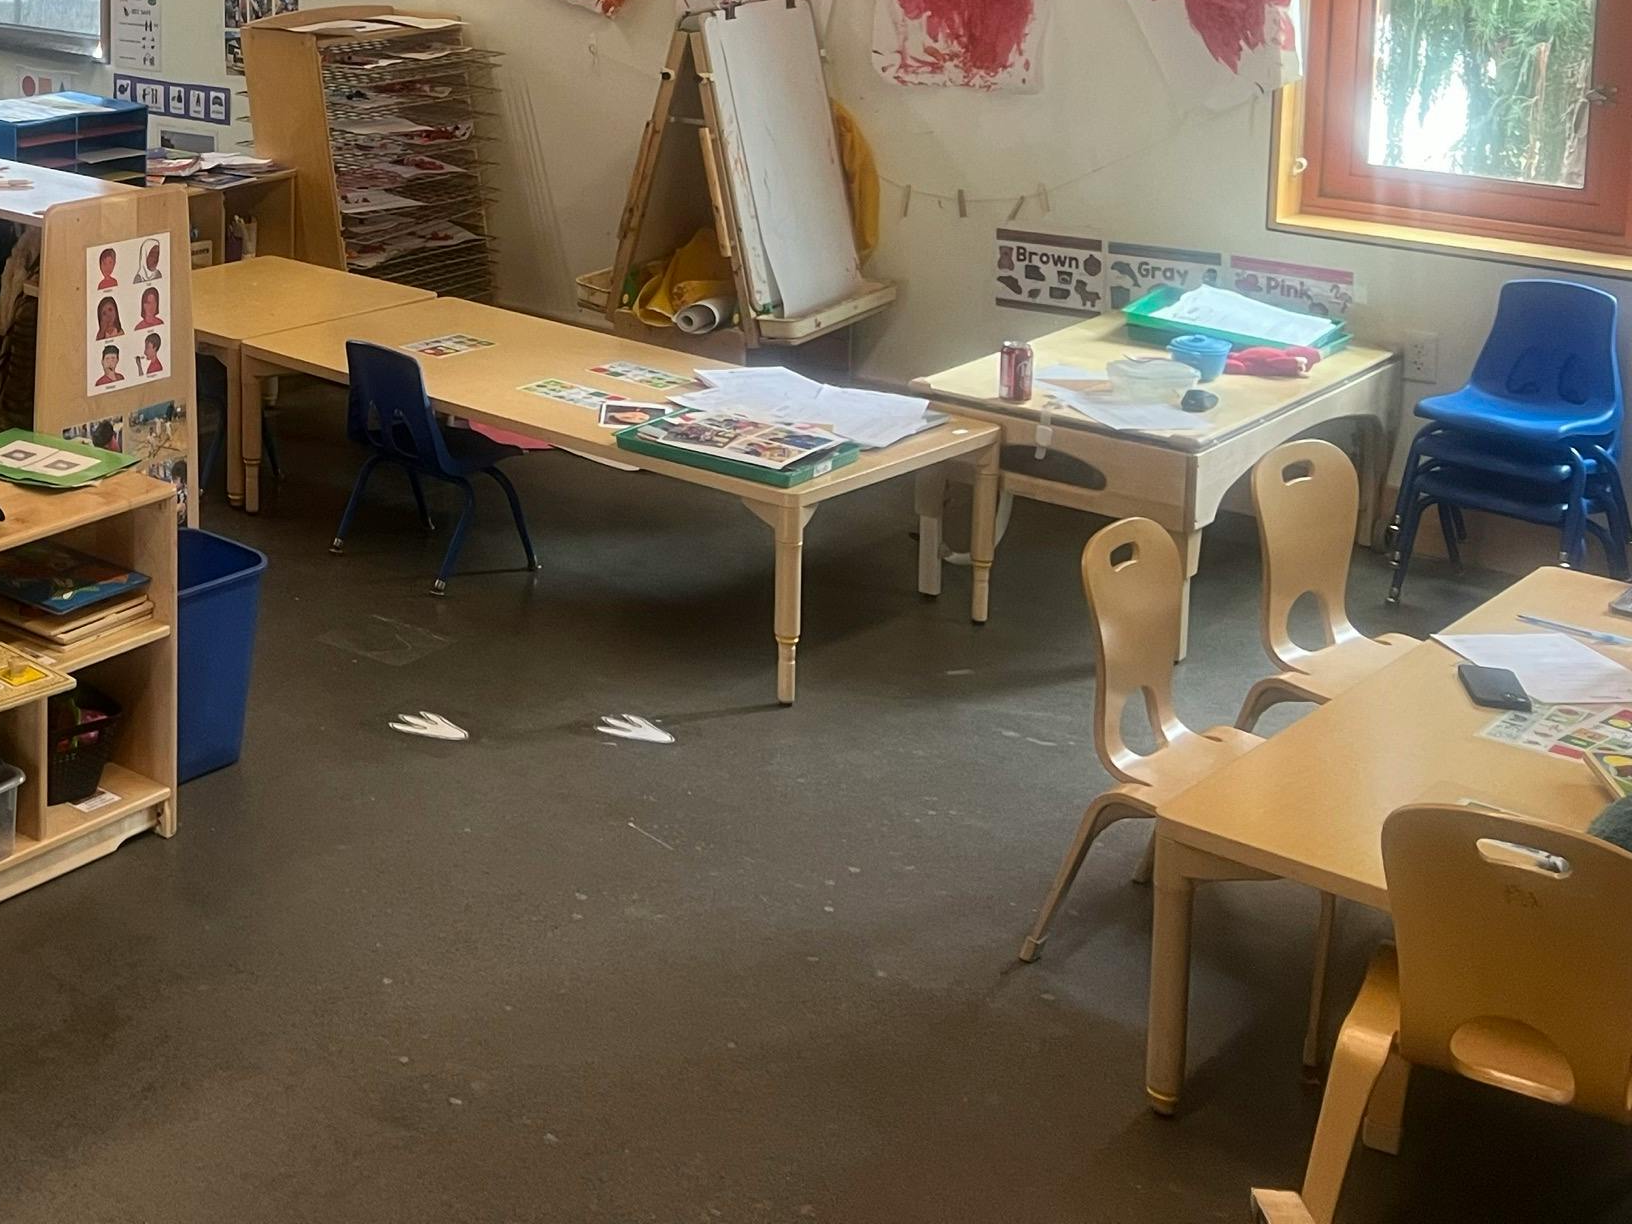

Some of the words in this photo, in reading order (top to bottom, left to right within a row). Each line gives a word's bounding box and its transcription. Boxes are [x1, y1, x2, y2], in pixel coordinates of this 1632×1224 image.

[1014, 245, 1080, 270] Brown
[1137, 261, 1189, 286] Gray
[1265, 275, 1311, 301] Pink
